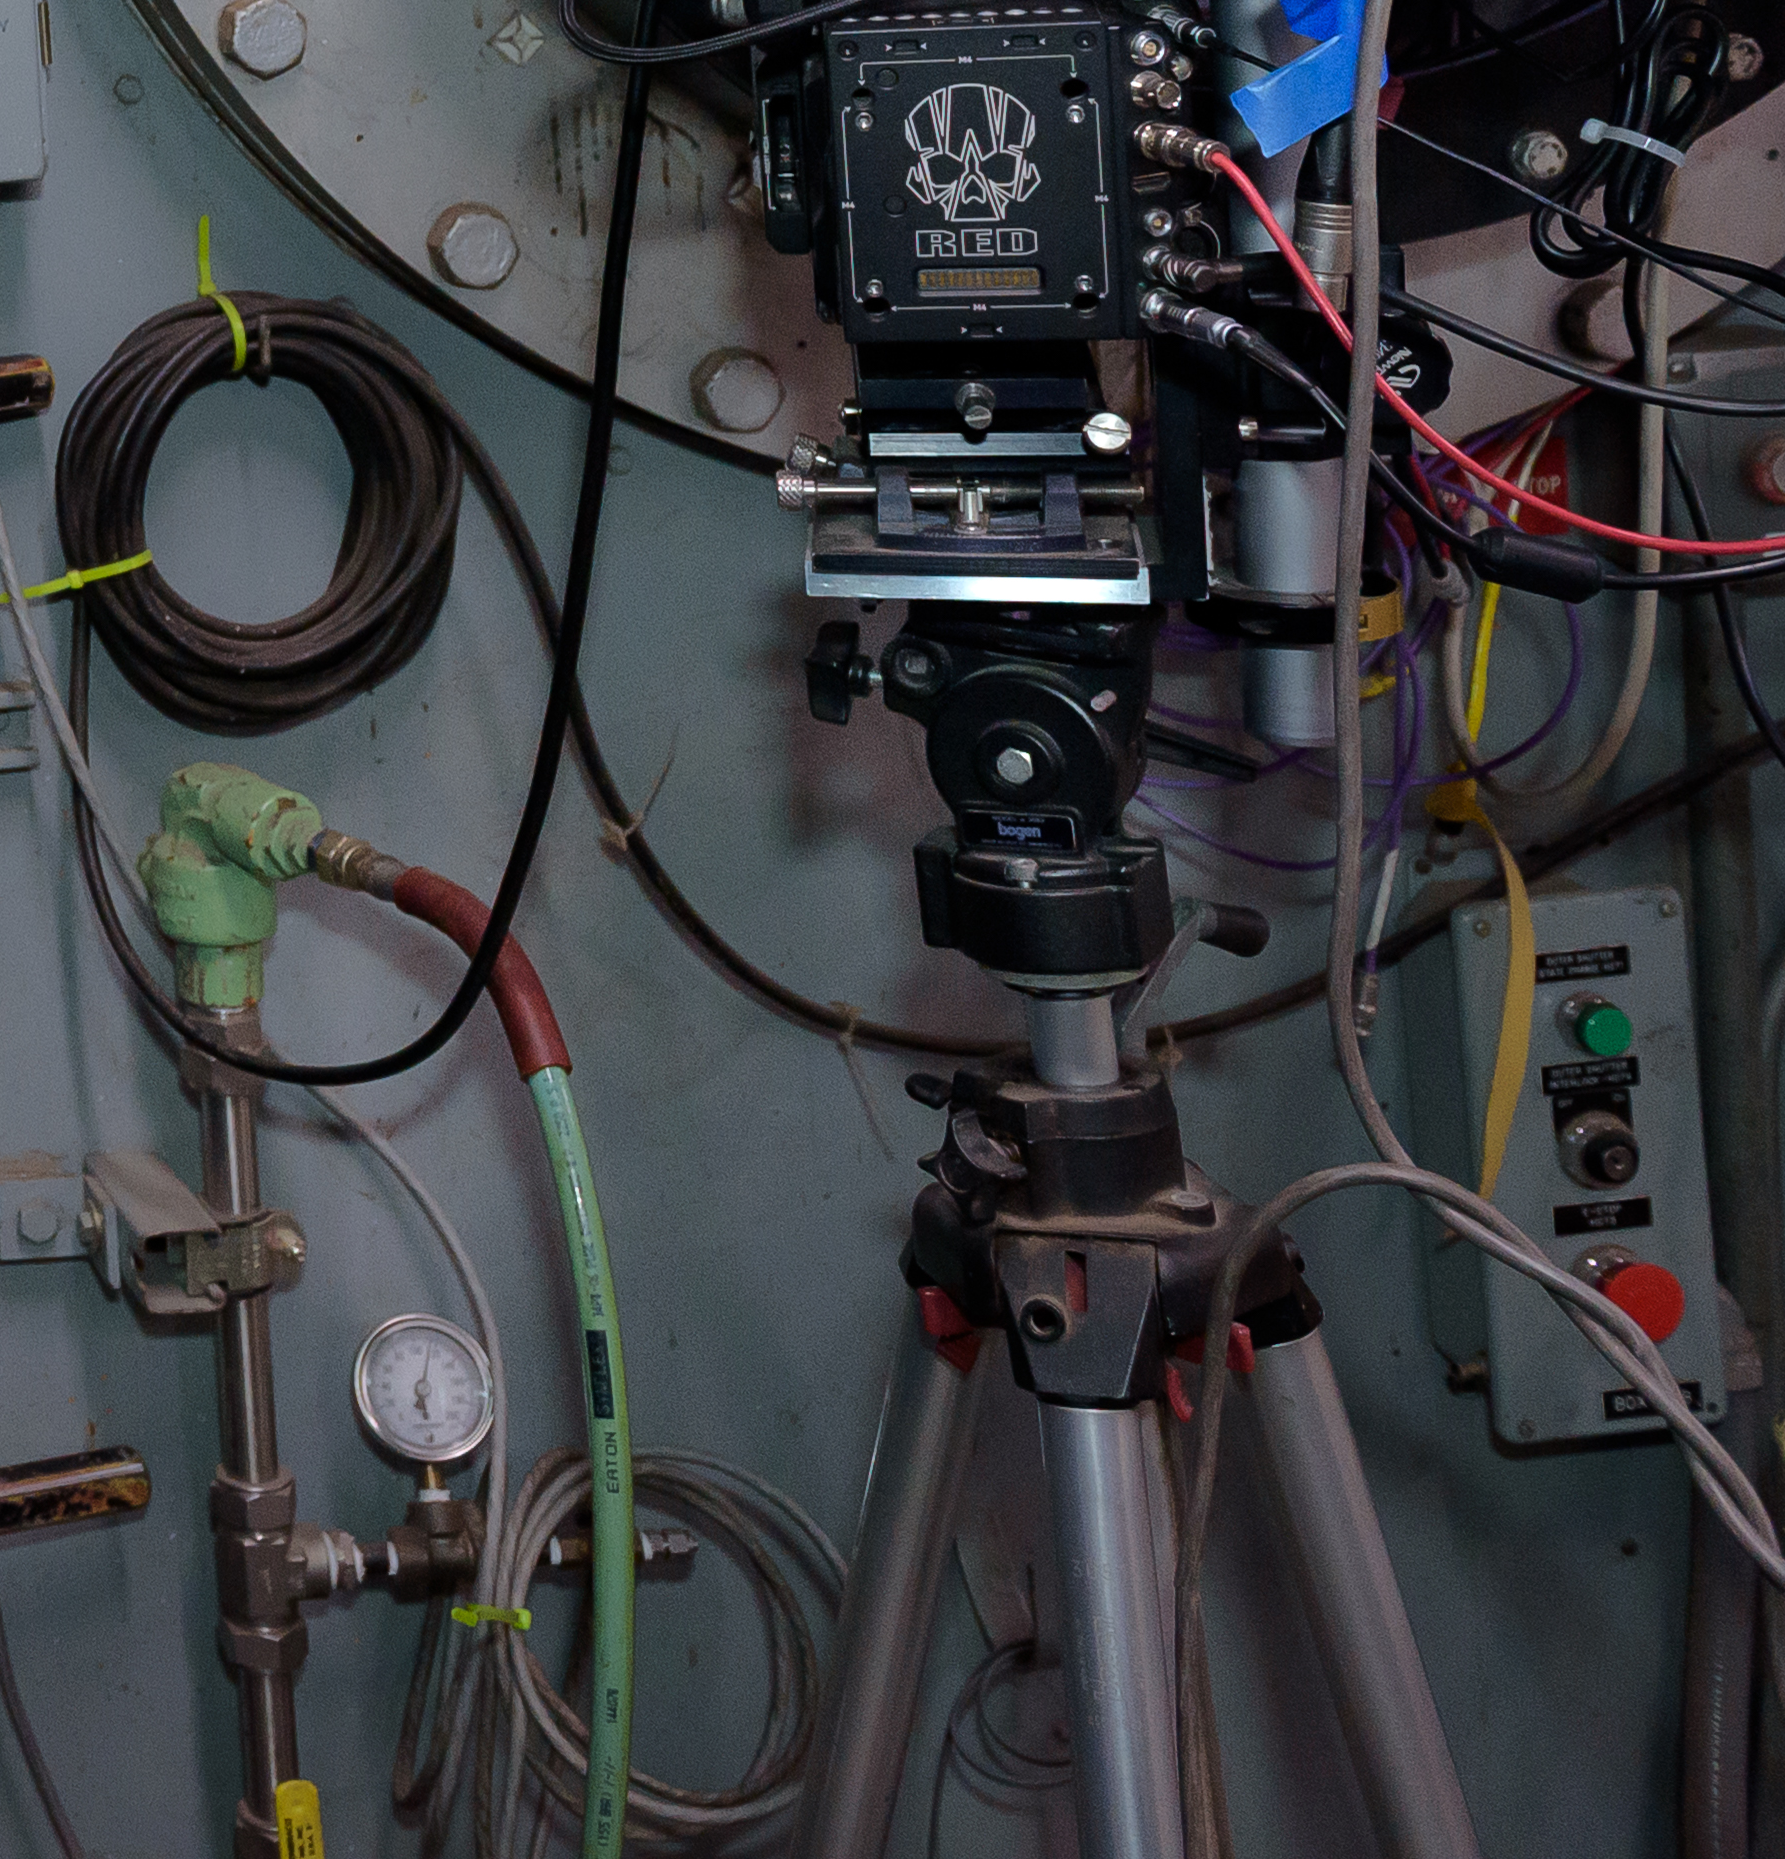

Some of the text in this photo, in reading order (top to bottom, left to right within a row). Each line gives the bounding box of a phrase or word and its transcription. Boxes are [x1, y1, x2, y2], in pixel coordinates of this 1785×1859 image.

[915, 227, 1038, 258] RED
[997, 821, 1042, 841] bogen
[604, 1430, 620, 1495] EATON
